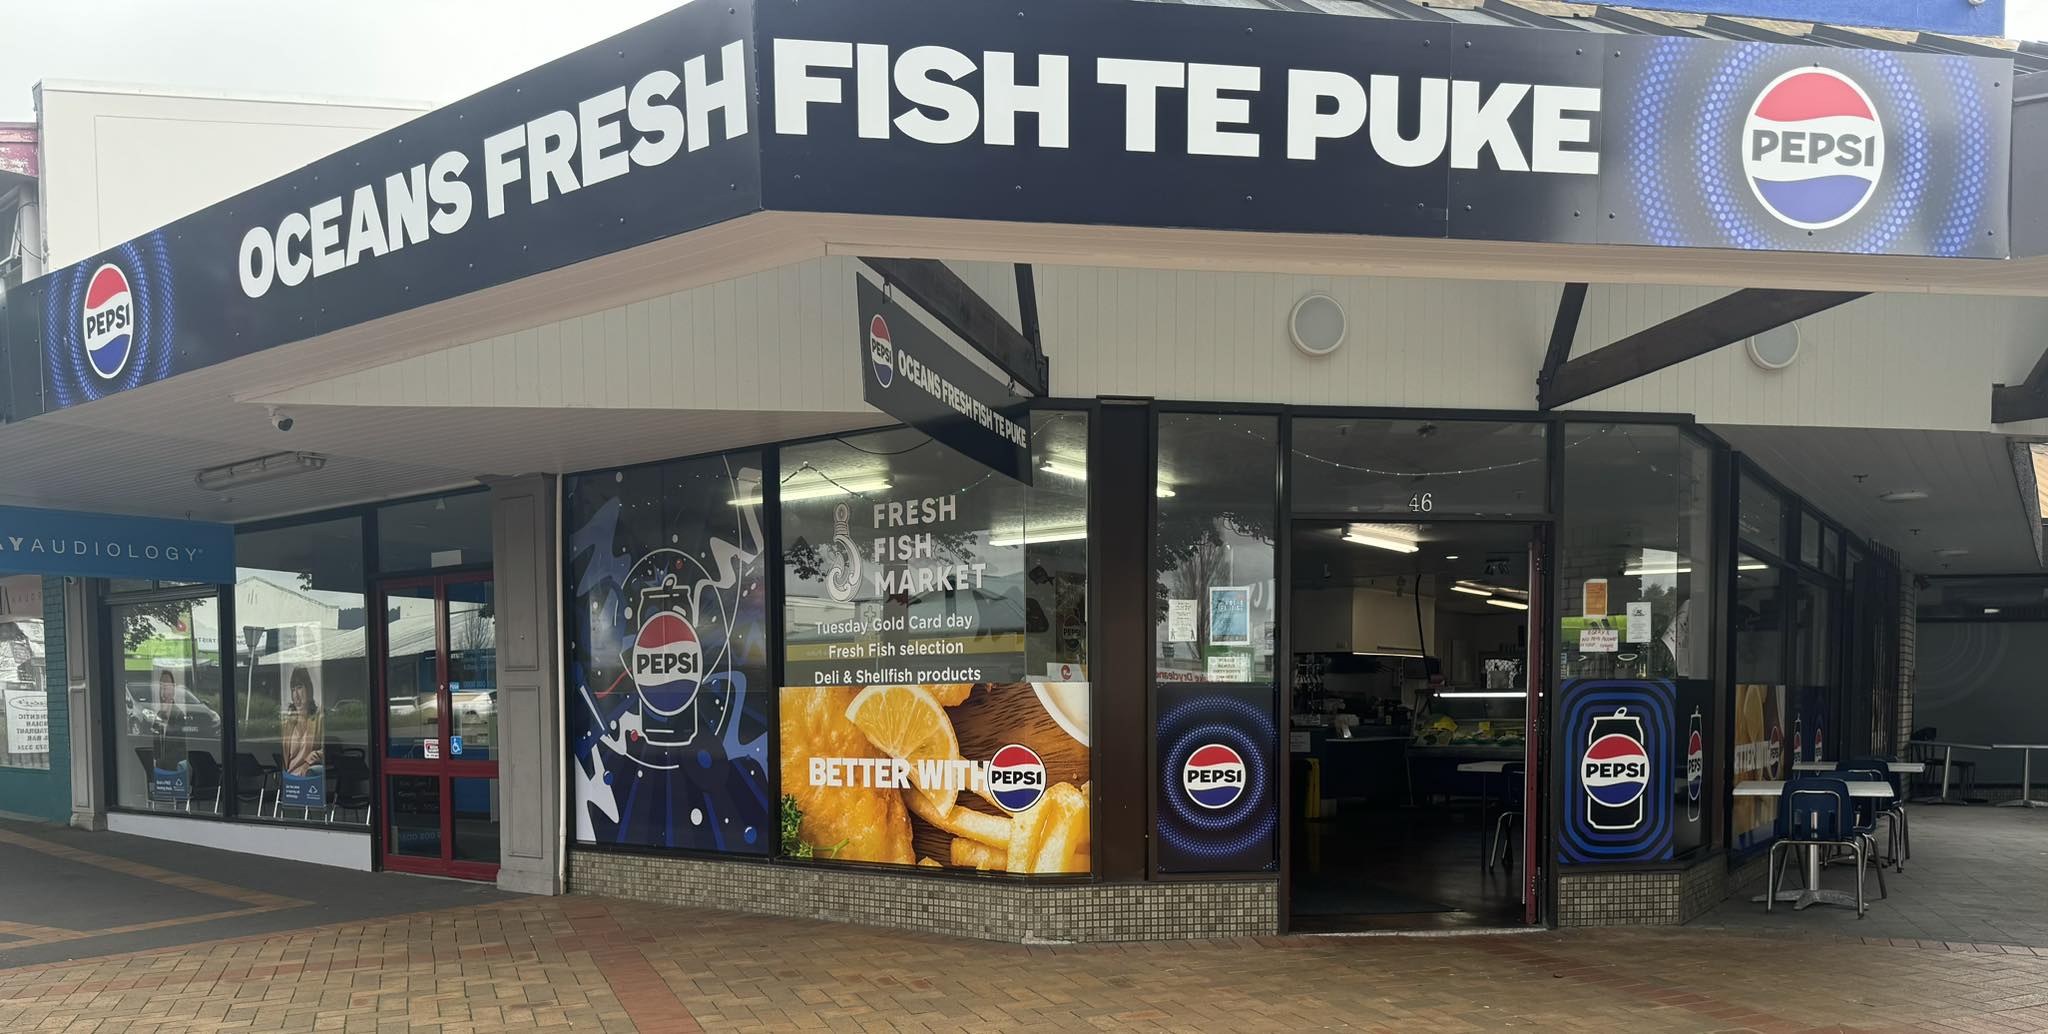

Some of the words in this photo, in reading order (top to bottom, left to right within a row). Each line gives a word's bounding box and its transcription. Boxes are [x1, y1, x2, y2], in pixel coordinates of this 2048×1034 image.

[1752, 129, 1876, 167] PEPSI
[239, 150, 473, 299] OCEANS
[484, 39, 748, 219] FRESH
[773, 38, 1069, 149] FISH
[1097, 57, 1261, 158] TE
[1287, 68, 1601, 175] PUKE
[87, 304, 130, 339] PEPSI
[872, 338, 891, 362] PEPSI
[898, 349, 941, 400] OCEANS
[942, 379, 972, 419] FRESH
[972, 399, 993, 431] FISH
[993, 412, 1006, 437] TE
[1005, 419, 1027, 449] PUKE
[873, 494, 957, 529] FRESH
[1409, 494, 1432, 511] 46
[31, 538, 197, 561] AUDIOLOGY
[874, 532, 932, 563] FISH
[874, 563, 987, 596] MARKET
[815, 618, 869, 636] Tuesday
[872, 616, 905, 631] Gold
[908, 613, 942, 629] Card
[946, 612, 973, 630] day
[828, 643, 864, 659] Fresh
[868, 641, 896, 657] Fish
[899, 639, 964, 656] selection
[636, 654, 698, 673] PEPSI
[814, 670, 839, 685] Deli
[843, 670, 853, 684] &
[855, 668, 913, 684] Shellfish
[916, 667, 982, 685] products
[809, 757, 911, 790] BETTER
[917, 758, 990, 792] WITH
[991, 769, 1043, 786] PEPSI
[1188, 769, 1241, 784] PEPSI
[1586, 762, 1645, 777] PEPSI
